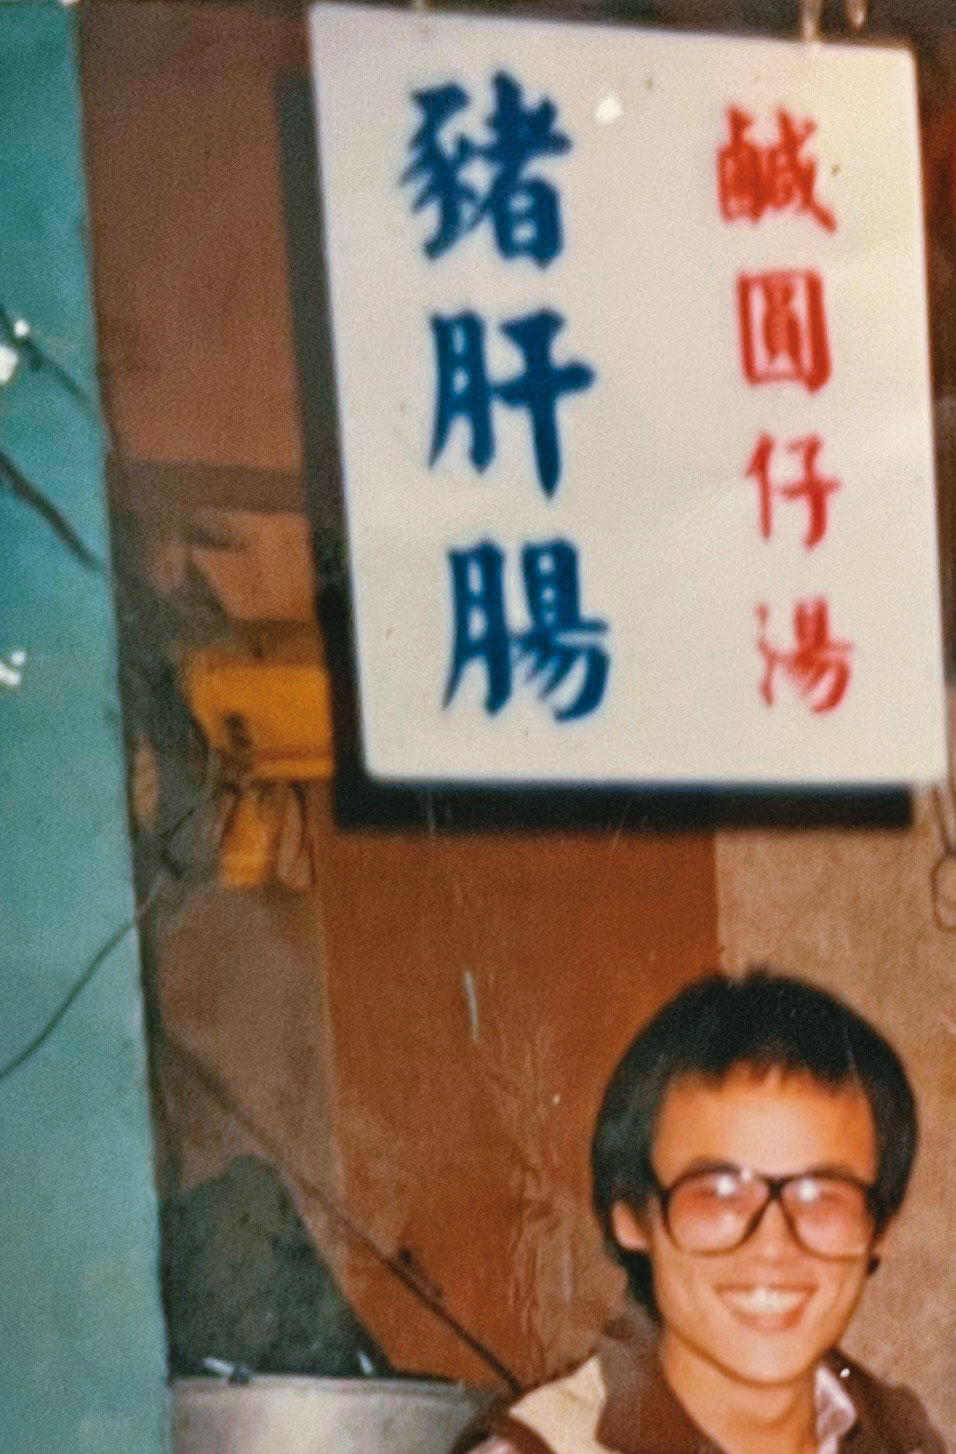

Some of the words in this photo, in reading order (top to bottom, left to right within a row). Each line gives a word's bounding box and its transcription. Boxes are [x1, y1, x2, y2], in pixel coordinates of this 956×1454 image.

[400, 70, 611, 722] 豬肝腸
[716, 103, 853, 714] 鹹圓仔湯
